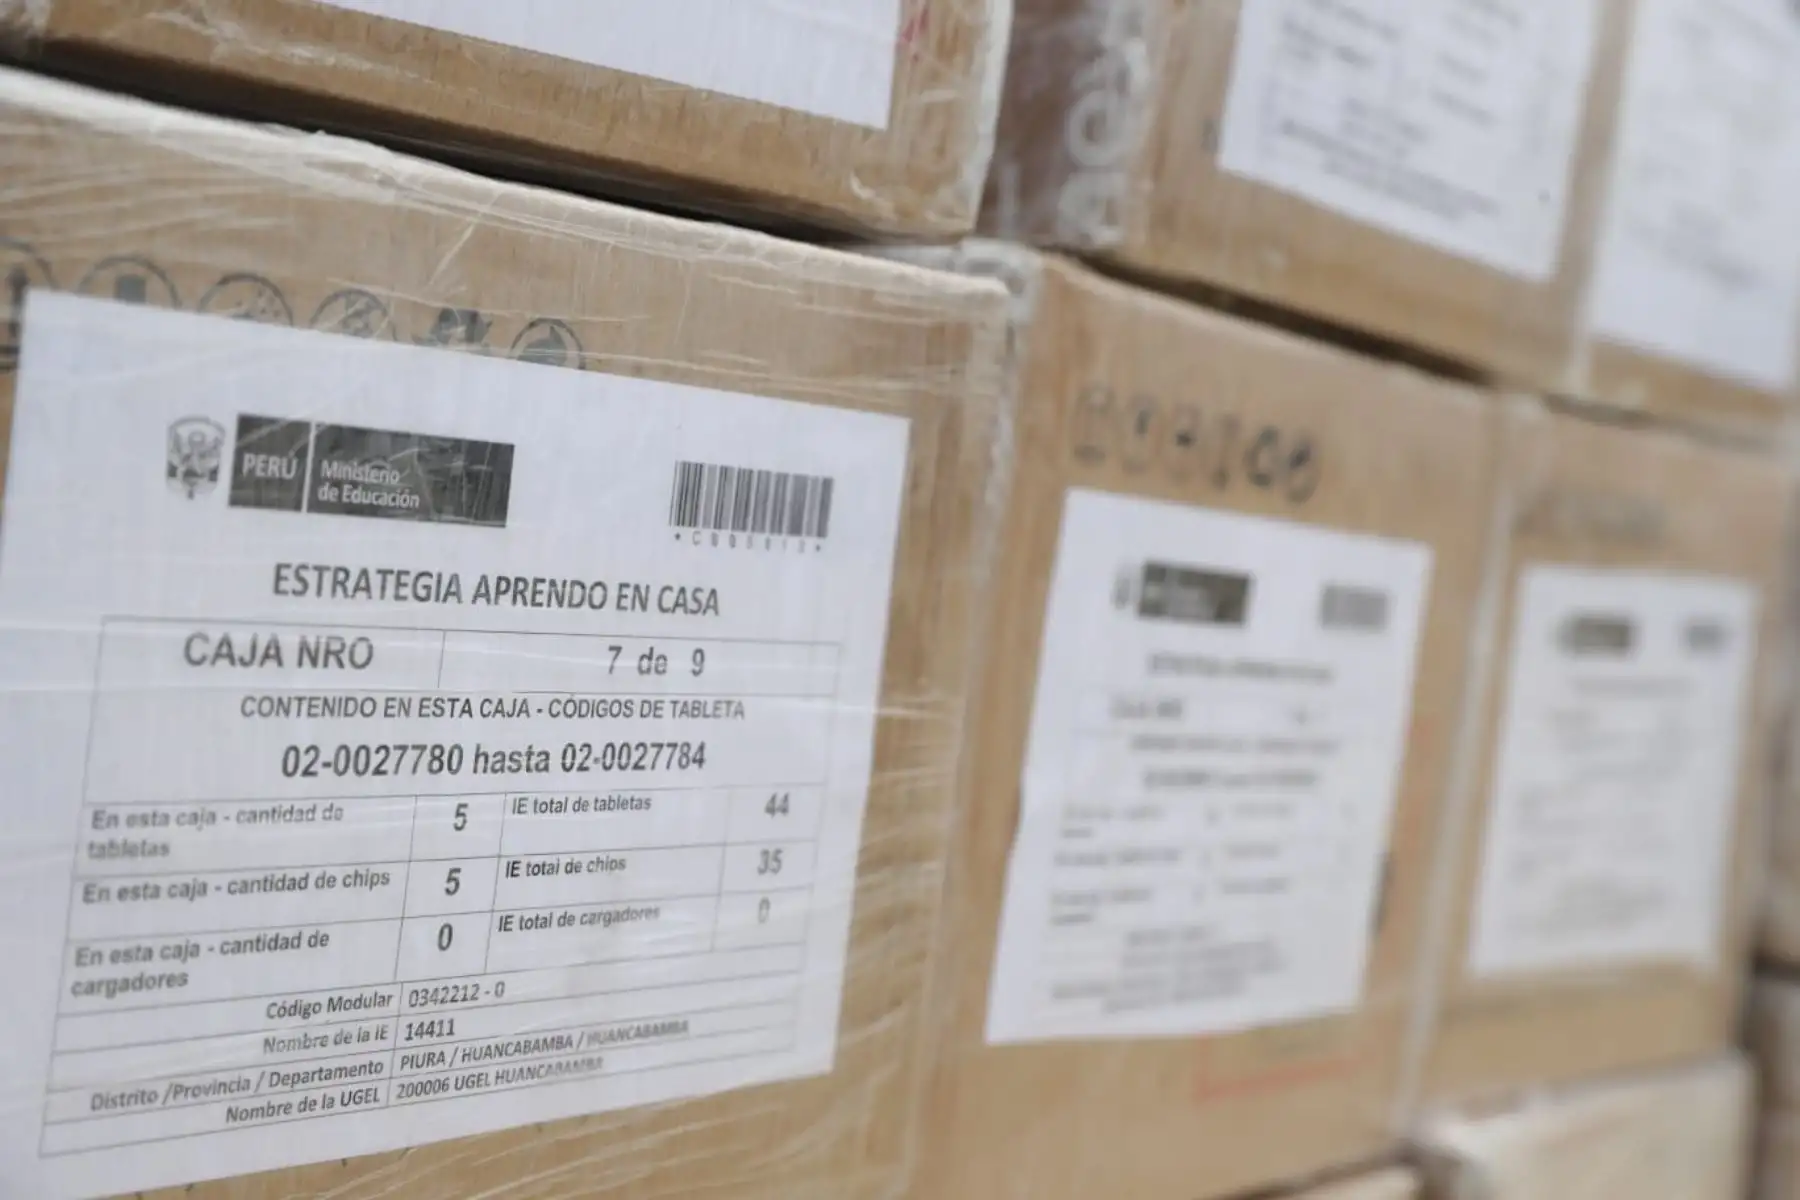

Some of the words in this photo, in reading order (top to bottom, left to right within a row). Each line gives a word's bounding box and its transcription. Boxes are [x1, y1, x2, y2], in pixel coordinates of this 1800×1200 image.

[320, 459, 400, 486] Ministerio
[318, 482, 337, 502] de
[342, 482, 420, 509] Educación
[273, 562, 463, 604] ESTRATEGIA
[472, 573, 607, 611] APRENDO
[615, 582, 649, 612] EN
[657, 585, 720, 616] CASA
[183, 632, 283, 669] CAJA
[297, 635, 374, 670] NRO
[607, 645, 622, 674] 7
[637, 647, 668, 675] de
[691, 648, 706, 677] 9
[240, 695, 377, 719] CONTENIDO
[384, 697, 412, 718] EN
[418, 697, 473, 718] ESTA
[480, 698, 530, 719] CAJA
[549, 694, 634, 719] CÓDIGOS
[640, 699, 664, 720] DE
[671, 699, 745, 720] TABLETA
[281, 744, 463, 778] 02-0027780
[472, 743, 551, 775] hasta
[560, 742, 706, 773] 02-0027784
[91, 809, 119, 831] En
[125, 808, 169, 828] esta
[175, 806, 217, 832] caja
[236, 803, 317, 825] cantidad
[322, 802, 344, 822] de
[453, 803, 468, 832] 5
[512, 797, 528, 815] IE
[533, 796, 568, 814] total
[572, 796, 589, 813] de
[593, 794, 652, 813] tabletas
[764, 792, 790, 818] 44
[87, 839, 171, 861] tabletas
[757, 849, 782, 875] 35
[505, 860, 521, 878] IE
[525, 858, 560, 877] total
[564, 856, 582, 874] de
[586, 854, 626, 876] chips
[83, 883, 110, 904] En
[116, 882, 162, 902] esta
[167, 877, 208, 904] caja
[227, 872, 309, 896] cantidad
[314, 871, 337, 890] de
[341, 867, 391, 893] chips
[444, 867, 461, 896] 5
[498, 915, 513, 932] IE
[519, 911, 554, 931] total
[558, 909, 576, 928] de
[580, 906, 661, 931] cargadores
[75, 947, 102, 968] En
[109, 944, 153, 964] esta
[159, 941, 200, 967] caja
[219, 932, 302, 957] cantidad
[307, 930, 330, 950] de
[437, 922, 453, 951] 0
[71, 972, 189, 999] cargadores
[408, 983, 480, 1007] 0342212
[494, 981, 505, 998] 0
[266, 1000, 322, 1020] Código
[327, 992, 394, 1013] Modular
[263, 1033, 328, 1055] Nombre
[334, 1028, 353, 1046] de
[356, 1027, 370, 1044] la
[374, 1024, 389, 1041] IE
[404, 1018, 455, 1041] 14411
[400, 1050, 446, 1071] PIURA
[450, 1047, 459, 1067] /
[461, 1033, 573, 1063] HUANCABAMBA
[586, 1019, 690, 1048] HUANCABAMBA
[90, 1087, 159, 1112] Distrito
[254, 1071, 266, 1094] /
[268, 1060, 384, 1090] Departamento
[397, 1077, 450, 1099] 200006
[454, 1069, 491, 1091] UGEL
[495, 1057, 603, 1086] HUANCABAMBA
[225, 1097, 292, 1123] Nombre
[297, 1095, 317, 1113] de
[322, 1091, 334, 1109] la
[340, 1087, 381, 1107] UGEL
